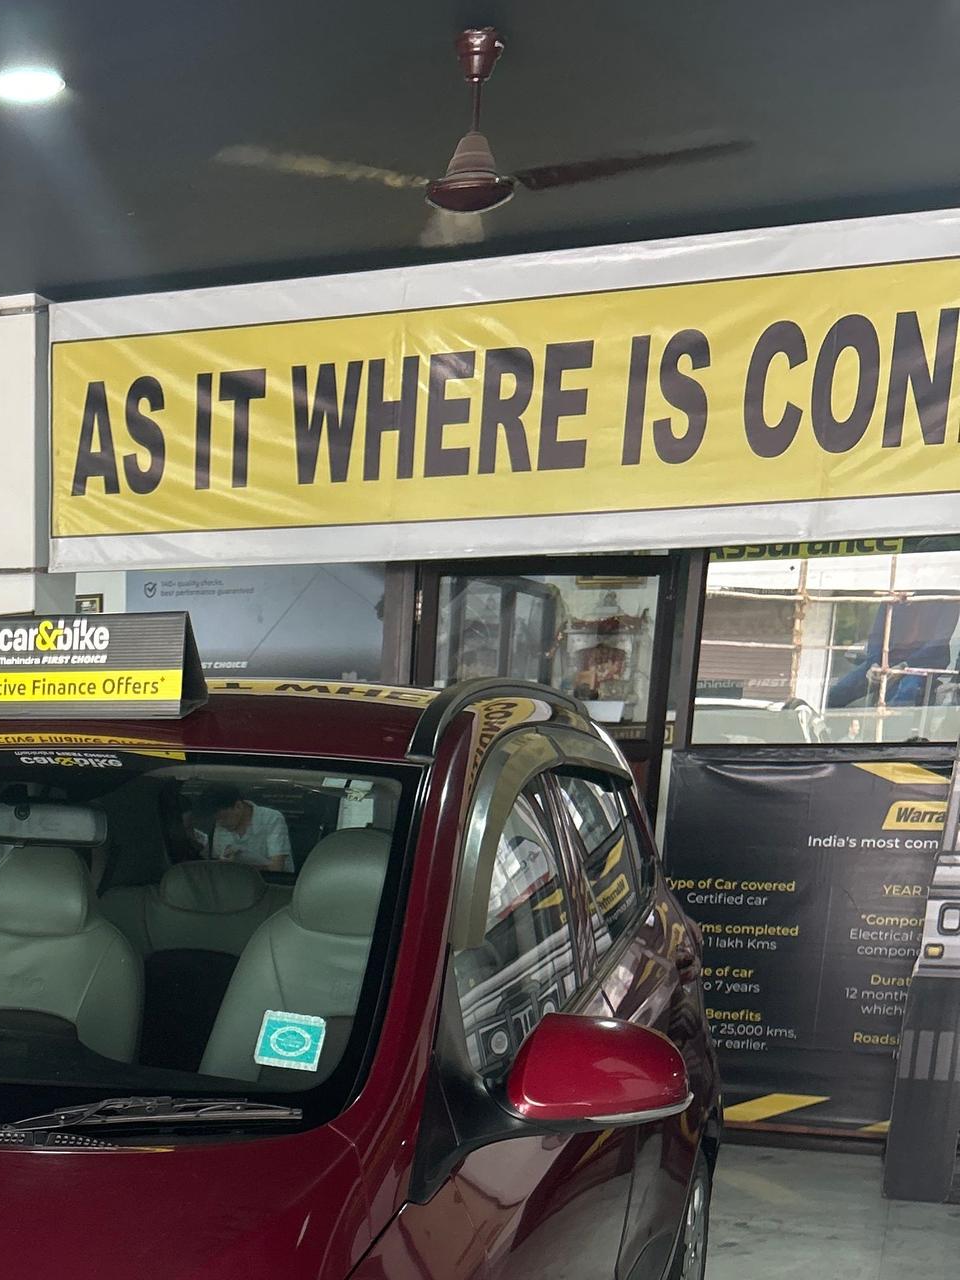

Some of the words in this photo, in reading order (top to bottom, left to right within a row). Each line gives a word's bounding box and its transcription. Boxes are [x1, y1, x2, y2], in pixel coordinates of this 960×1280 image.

[71, 375, 166, 497] AS
[194, 368, 267, 490] IT
[291, 339, 595, 485] WHERE
[621, 328, 712, 465] IS
[743, 307, 960, 459] CON
[41, 655, 71, 665] FIRST
[71, 654, 108, 664] CHOICE
[213, 661, 248, 669] CHOICE
[32, 678, 96, 696] Finance
[808, 835, 857, 848] India's
[861, 837, 900, 849] most
[697, 878, 713, 889] of
[714, 878, 737, 890] Car
[741, 880, 796, 892] covered
[883, 884, 922, 896] YEAR
[687, 892, 743, 905] Certified
[746, 896, 768, 906] car
[725, 924, 799, 937] completed
[849, 928, 913, 941] Electrical
[715, 936, 743, 949] lakh
[747, 938, 777, 950] Kms
[715, 966, 730, 977] of
[732, 968, 754, 978] car
[715, 981, 723, 991] 7
[725, 982, 761, 994] years
[845, 987, 858, 1000] 12
[705, 1008, 762, 1022] Benefits
[861, 1003, 906, 1016] which
[720, 1023, 763, 1036] 25,000
